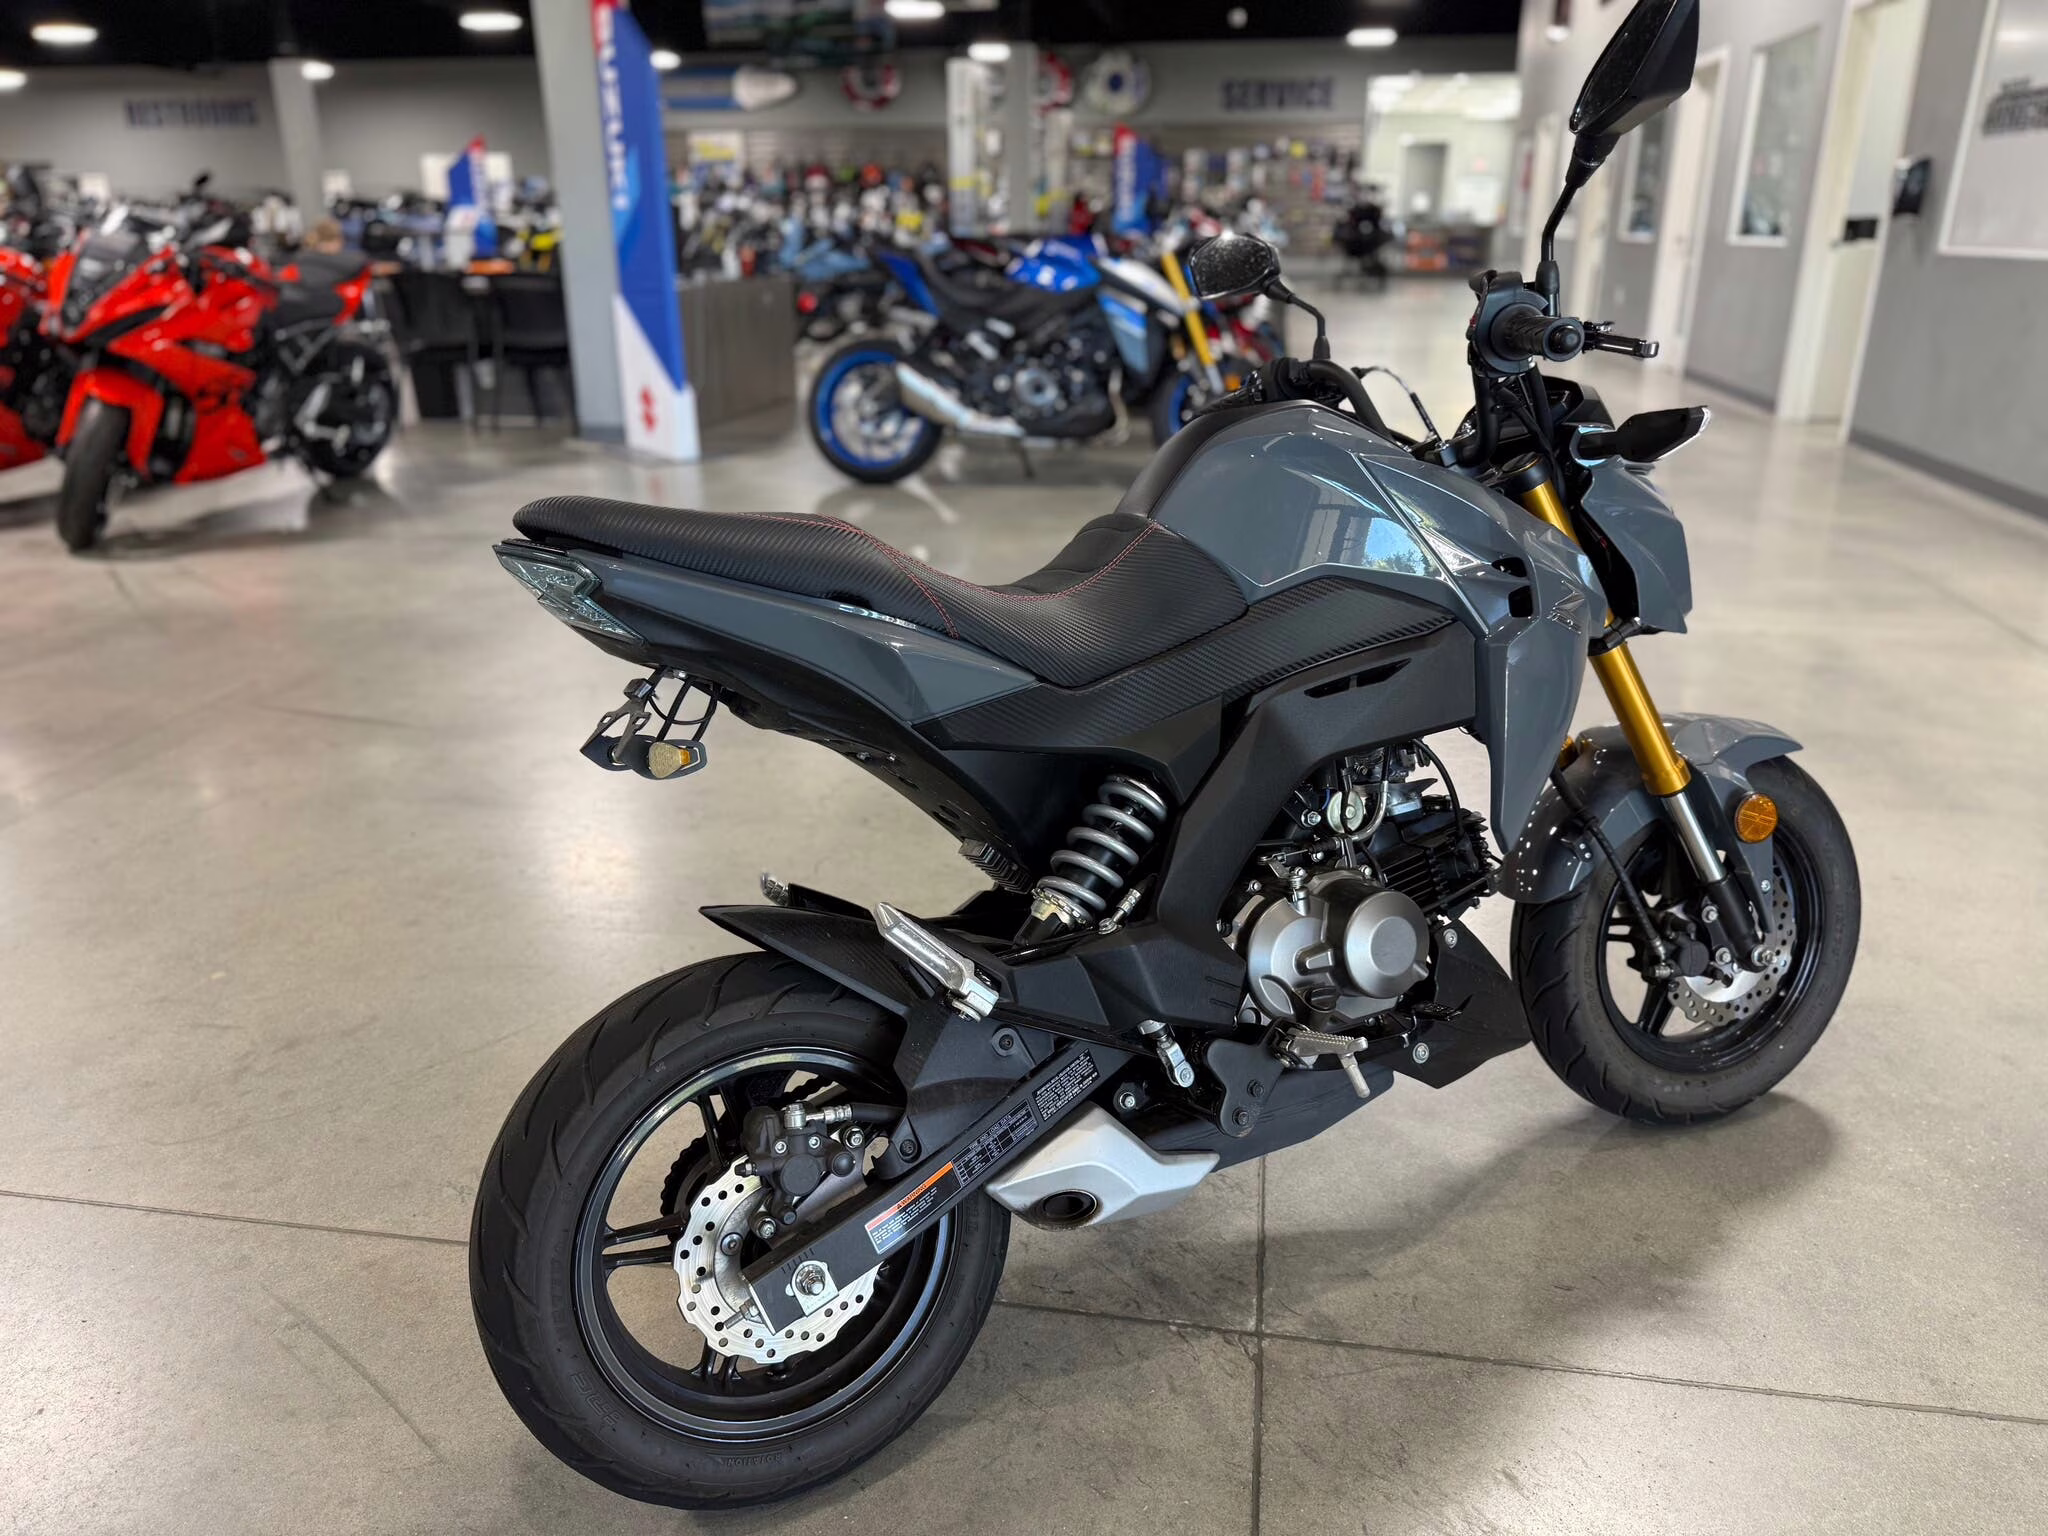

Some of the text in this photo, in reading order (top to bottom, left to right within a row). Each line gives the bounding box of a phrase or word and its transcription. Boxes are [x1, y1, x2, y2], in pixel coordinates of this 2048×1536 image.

[1222, 78, 1336, 112] SERVICE
[900, 1184, 927, 1207] WARNING
[727, 1452, 783, 1467] ROTATION
